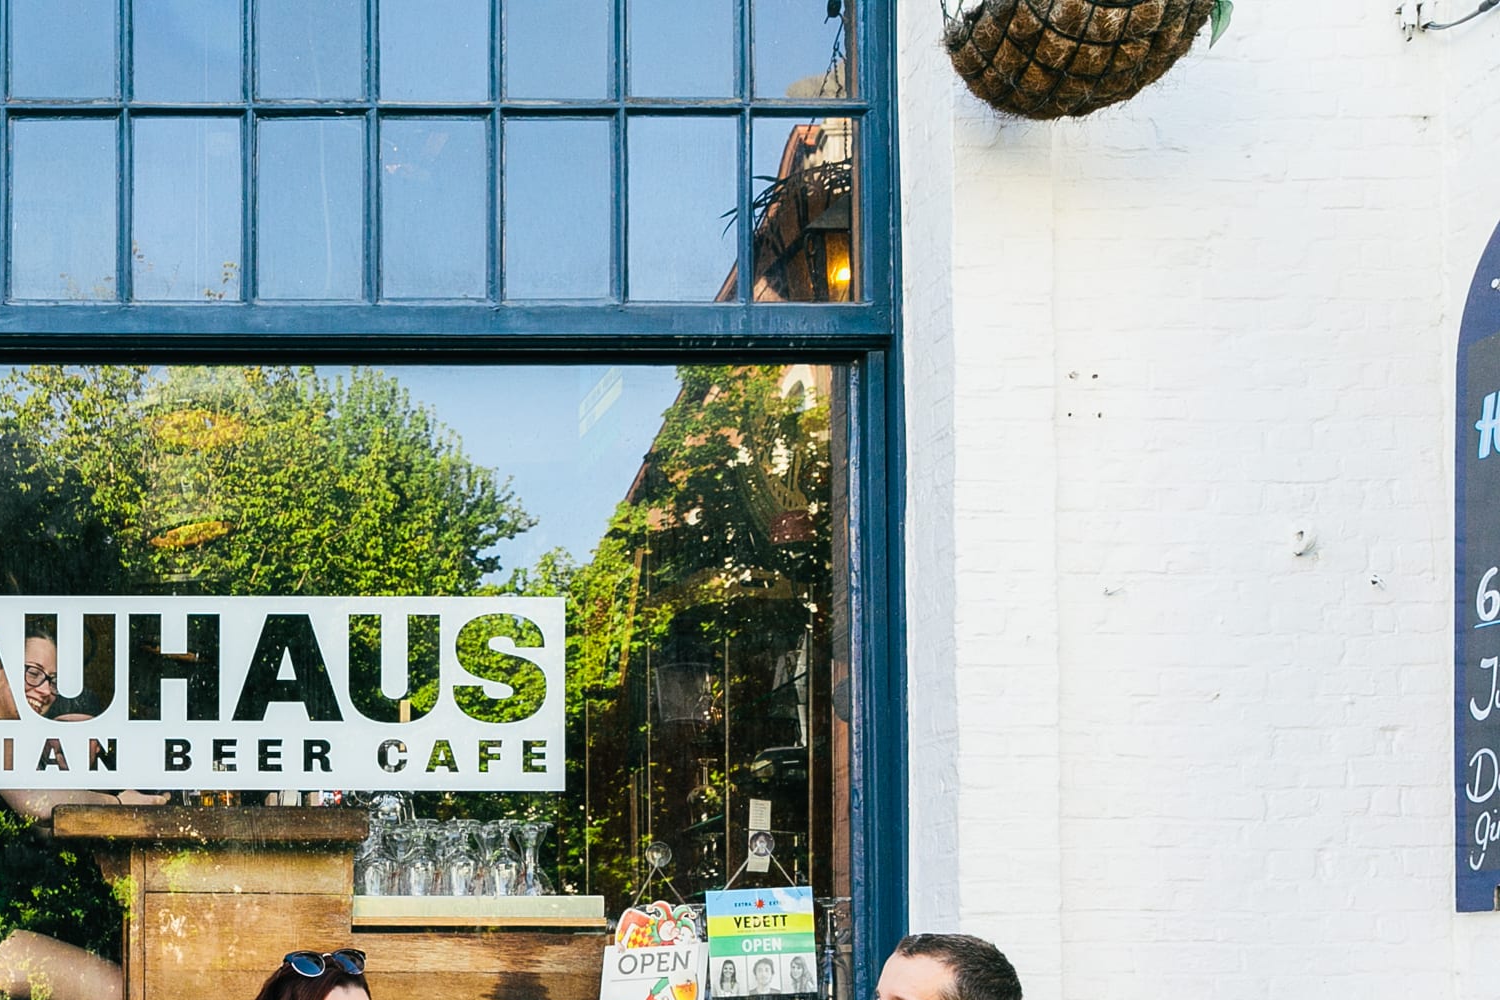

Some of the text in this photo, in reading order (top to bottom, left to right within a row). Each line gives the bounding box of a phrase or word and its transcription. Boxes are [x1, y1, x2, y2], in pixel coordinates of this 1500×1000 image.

[164, 738, 333, 773] BEER
[377, 738, 547, 774] CAFE
[733, 914, 788, 929] VEDETT
[742, 937, 782, 953] OPEN
[617, 950, 693, 975] OPEN
